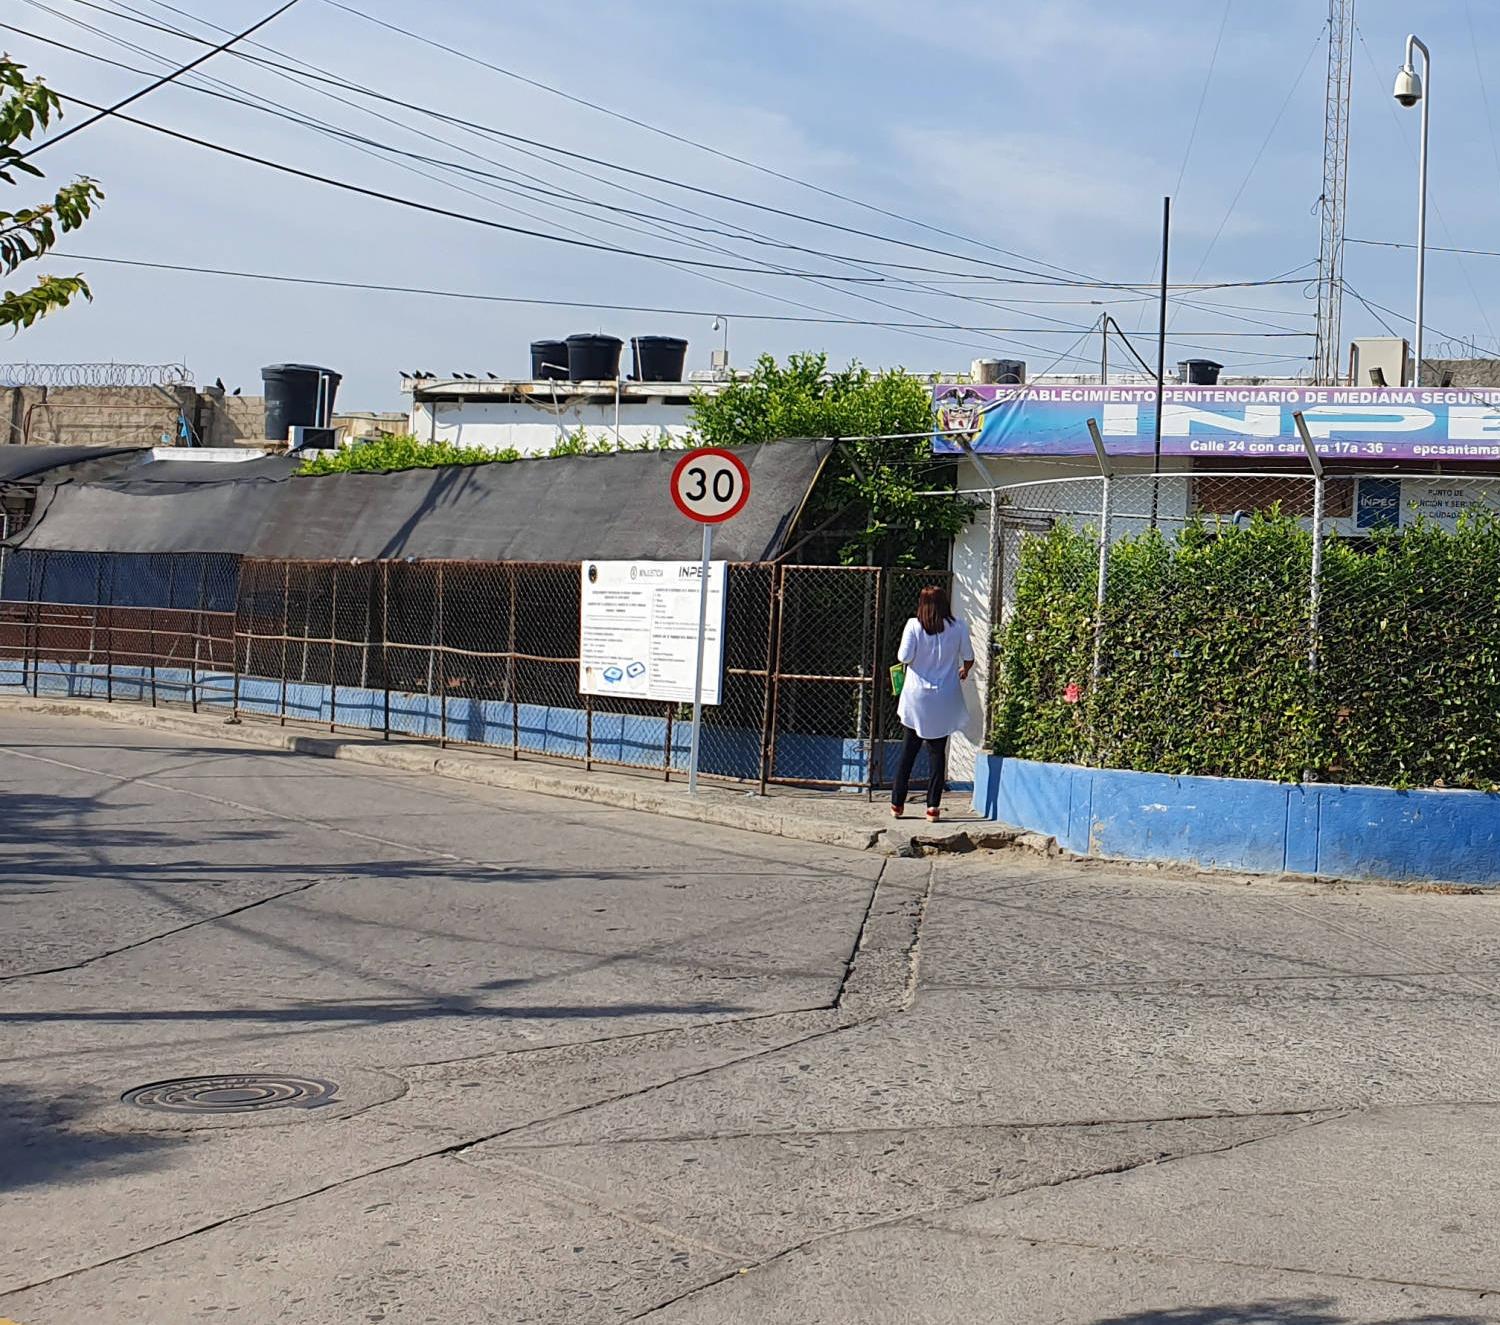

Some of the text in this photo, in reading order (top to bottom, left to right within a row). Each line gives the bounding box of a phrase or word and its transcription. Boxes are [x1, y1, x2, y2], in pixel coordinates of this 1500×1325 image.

[995, 389, 1156, 402] ESTABLECIMIENTO
[1162, 390, 1299, 403] PENITENCIARIO
[1305, 391, 1328, 404] DE
[1334, 391, 1415, 404] MEDIANA
[1190, 440, 1224, 452] Calle
[1228, 440, 1245, 452] 24
[1249, 443, 1274, 453] con
[1278, 443, 1329, 453] carrra
[1335, 441, 1358, 454] 17a
[1362, 441, 1383, 454] -36
[686, 467, 734, 502] 30
